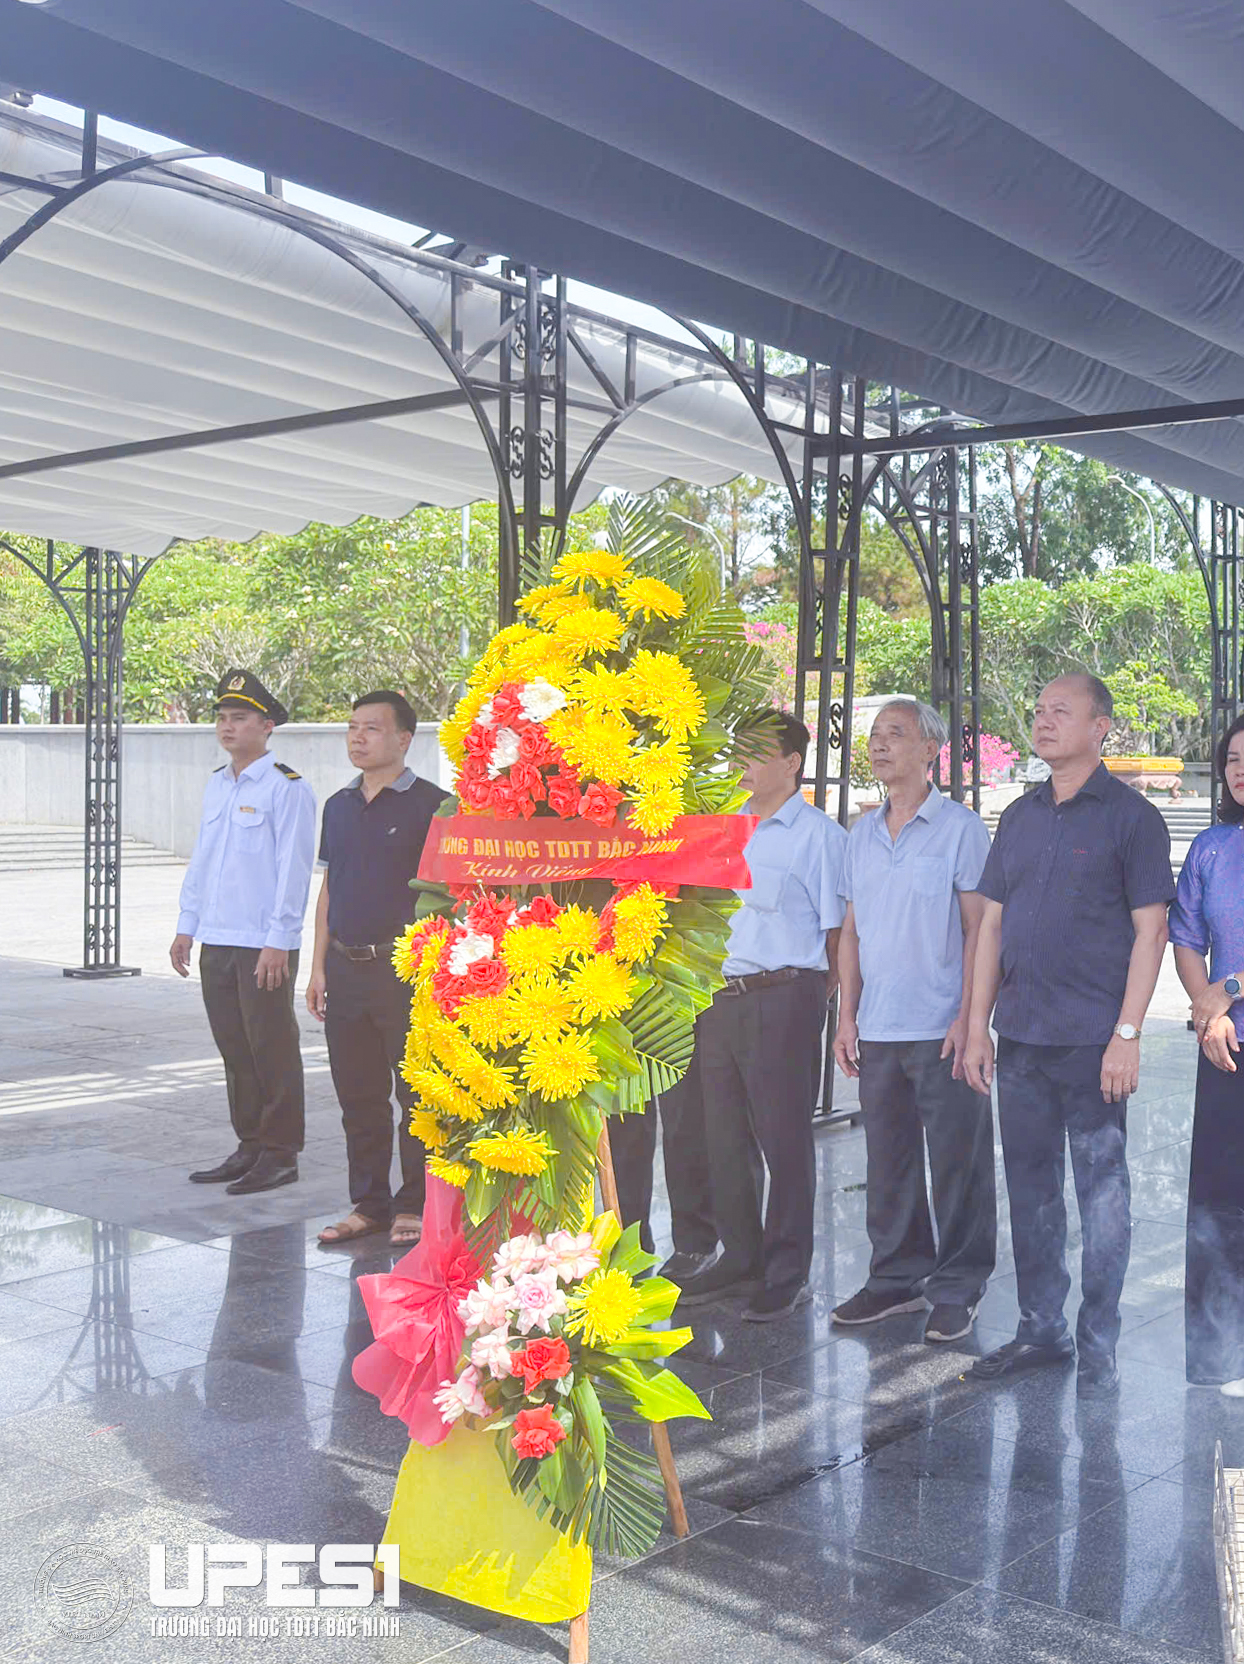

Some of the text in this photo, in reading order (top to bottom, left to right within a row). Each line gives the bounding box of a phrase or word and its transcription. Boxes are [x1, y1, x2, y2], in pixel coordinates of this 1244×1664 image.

[473, 838, 500, 860] ĐẠI
[504, 840, 540, 861] HỌC
[544, 840, 592, 858] TDTT
[598, 836, 636, 858] BẮC
[462, 861, 518, 877] Kính
